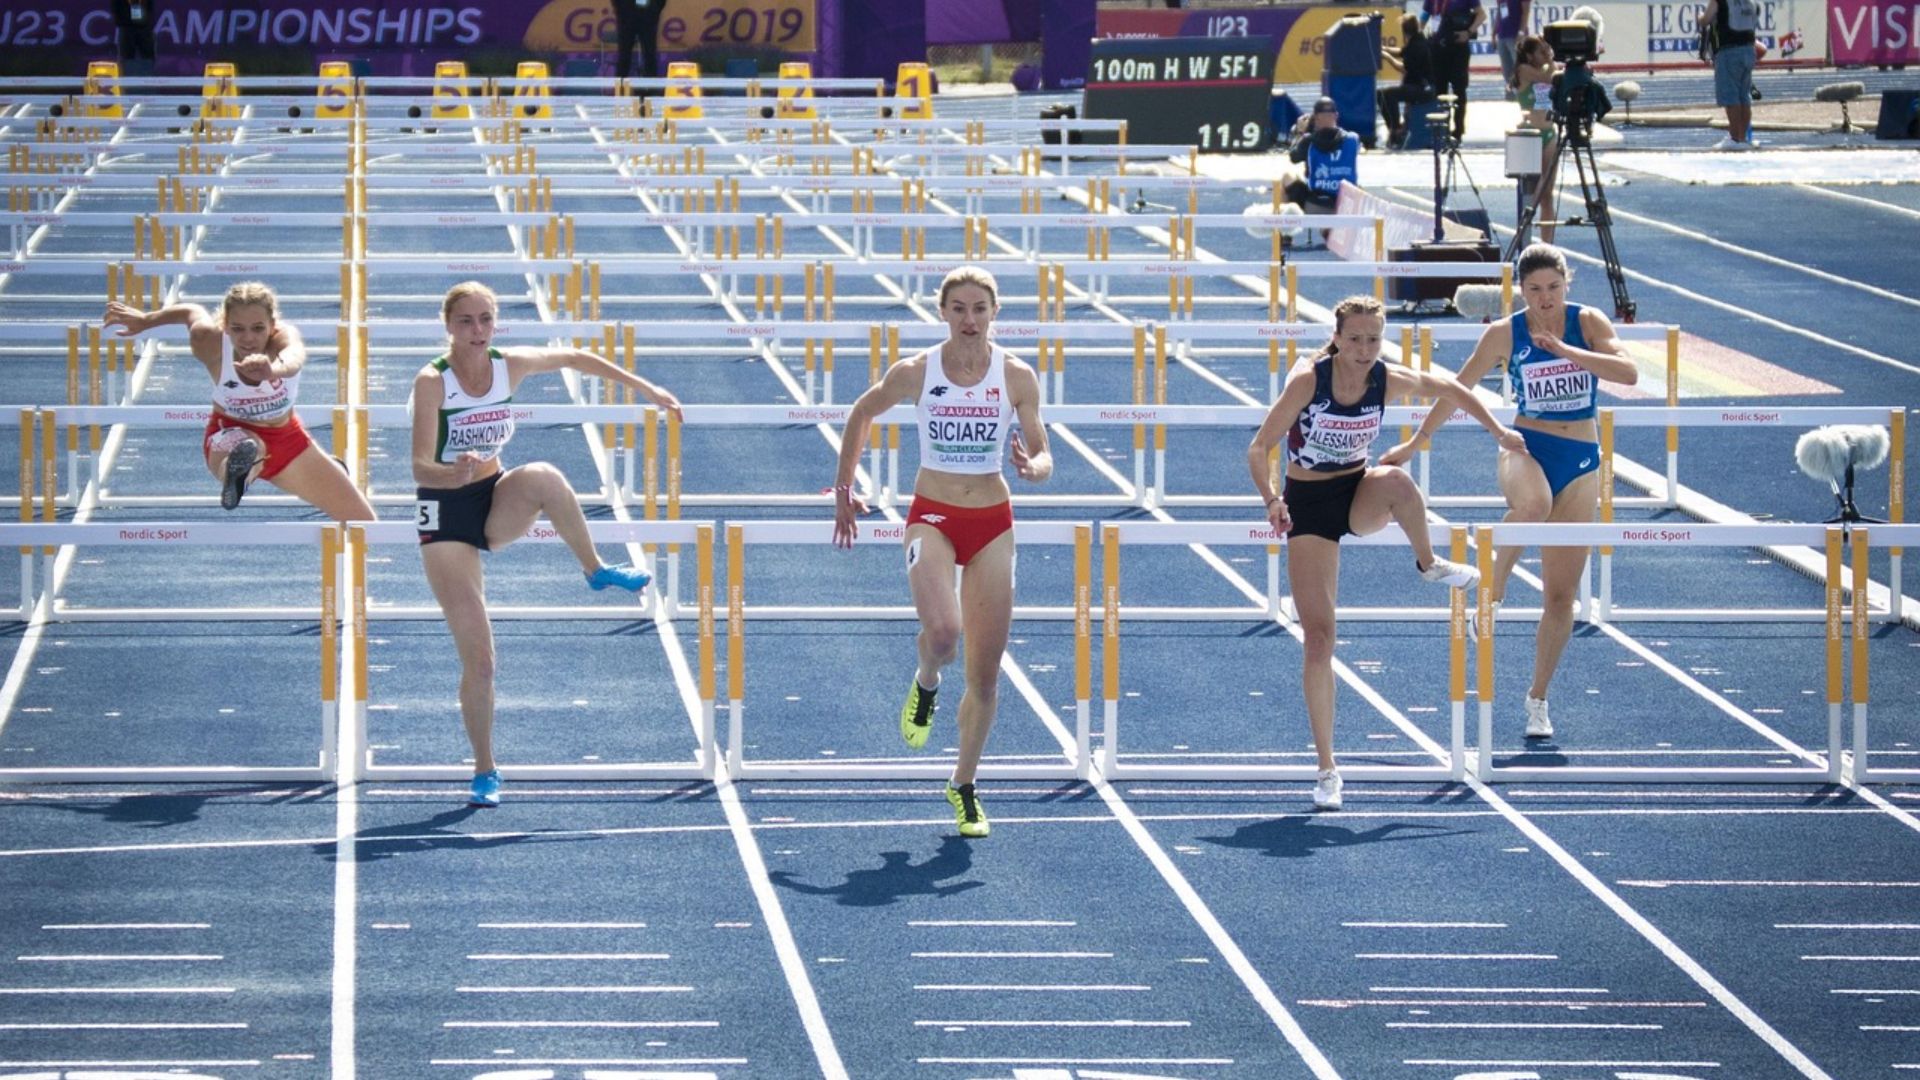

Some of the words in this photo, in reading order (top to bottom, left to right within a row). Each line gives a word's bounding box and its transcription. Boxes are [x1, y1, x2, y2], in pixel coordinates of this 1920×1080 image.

[1648, 4, 1673, 34] LE
[79, 9, 482, 45] CAMPIONSHIPS
[701, 8, 804, 44] 2019
[1094, 58, 1156, 81] 100m
[1163, 57, 1180, 80] H
[1189, 56, 1211, 80] W
[1219, 55, 1259, 78] SF1
[901, 76, 921, 111] 1
[1198, 122, 1261, 148] 11.9
[929, 385, 949, 397] 4F
[1527, 374, 1589, 400] MARINI
[165, 412, 197, 420] Nordic
[514, 411, 534, 421] port
[788, 411, 821, 419] Nordic
[823, 411, 846, 421] Sport
[940, 407, 999, 417] BAUHAUS
[1100, 411, 1129, 419] Nordic
[1131, 411, 1157, 421] Sport
[1722, 413, 1752, 421] Nordic
[1753, 413, 1779, 423] Sport
[1328, 418, 1378, 430] BAUHAUS
[928, 421, 998, 441] SICIARZ
[419, 505, 430, 526] 5
[119, 529, 155, 539] Nordic
[157, 529, 188, 542] Sport
[873, 528, 904, 538] Nordi
[1622, 530, 1659, 540] Nordic
[1660, 530, 1691, 542] Sport
